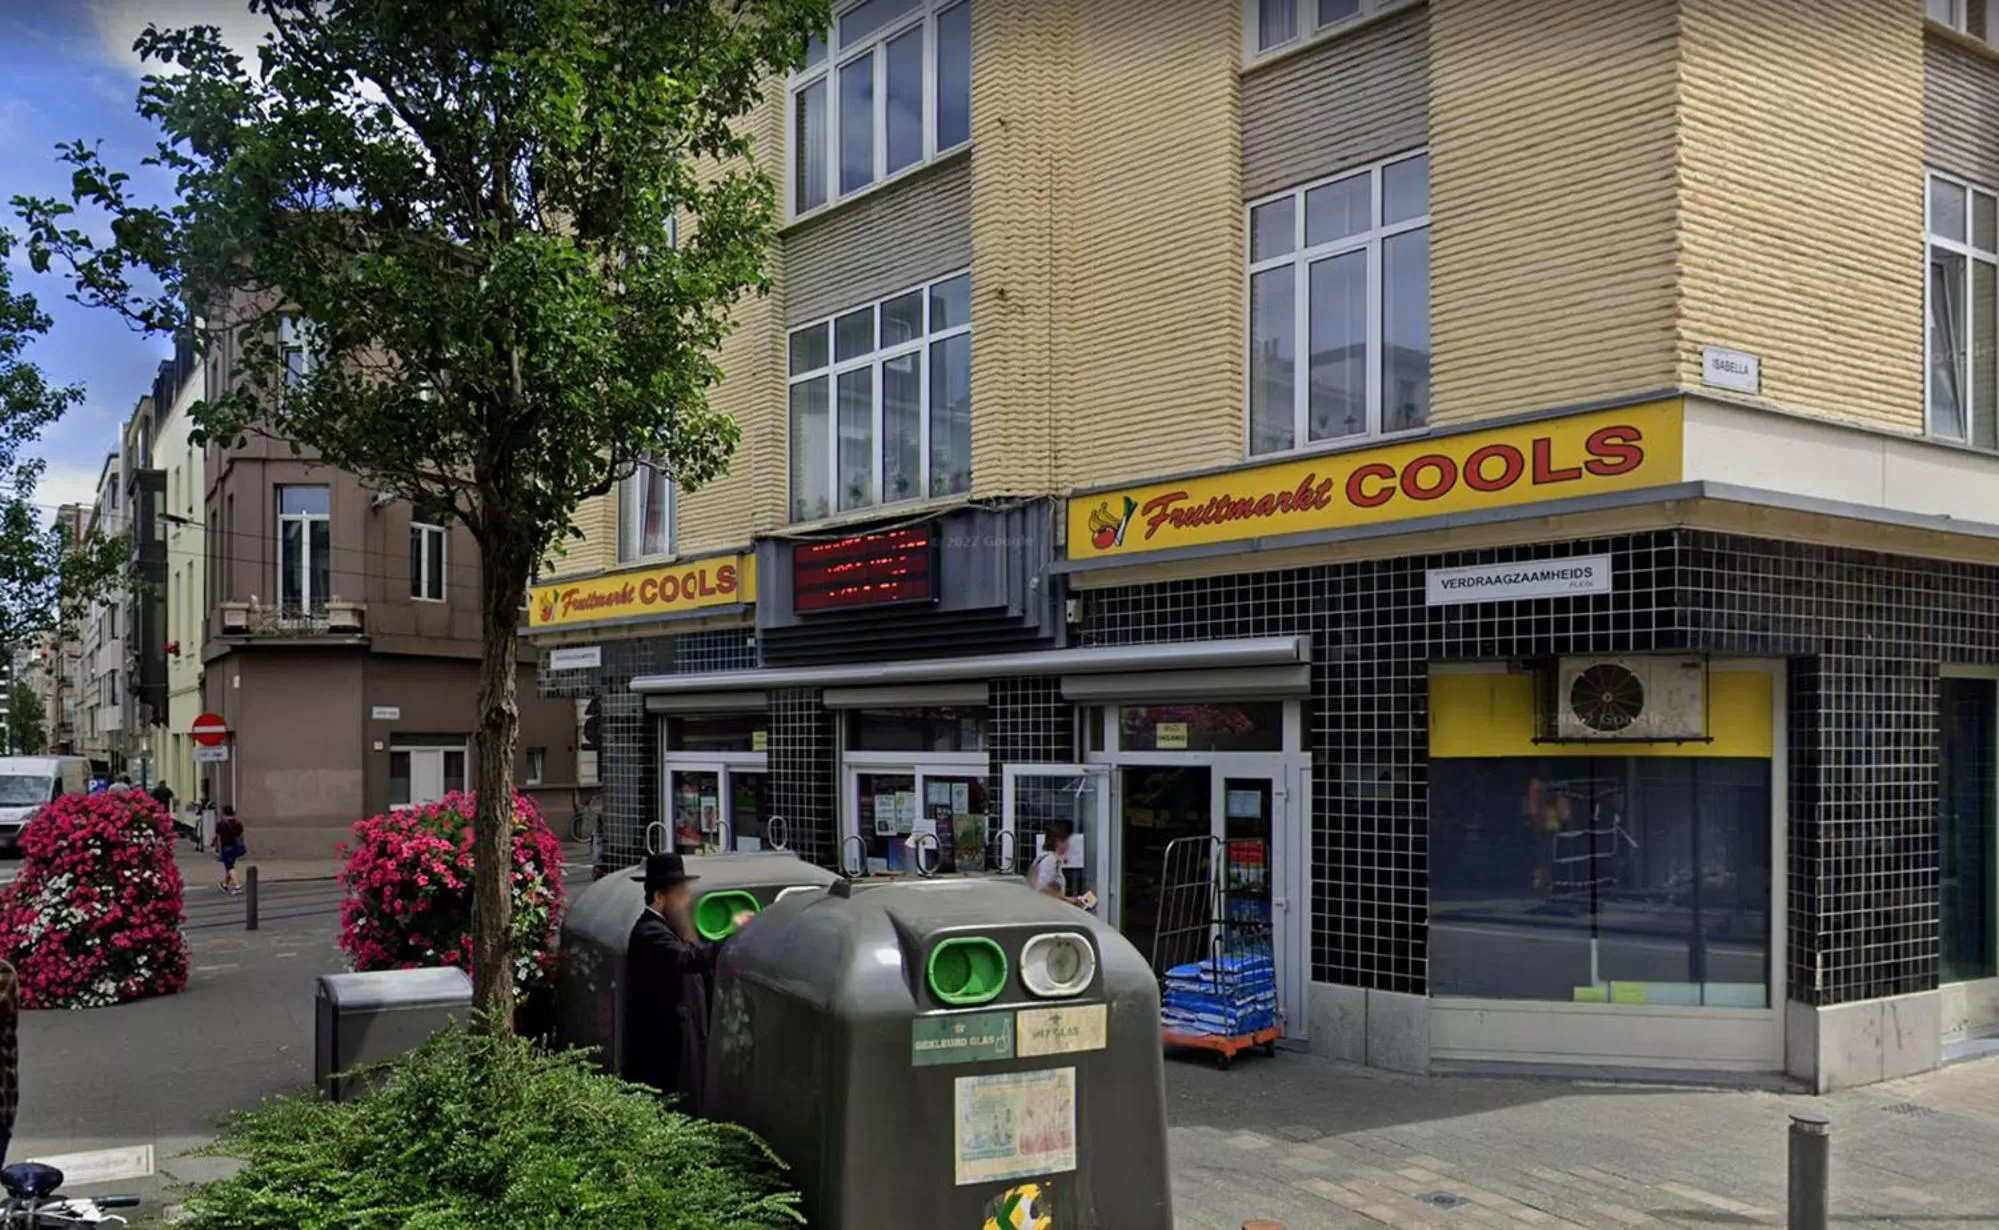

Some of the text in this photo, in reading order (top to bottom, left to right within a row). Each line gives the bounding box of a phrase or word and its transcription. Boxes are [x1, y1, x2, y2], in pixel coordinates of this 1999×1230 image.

[1711, 359, 1749, 375] ISABELLA
[1141, 425, 1645, 540] Fruitmarkt COOLS
[1441, 566, 1593, 589] VERDRAAGZAAMHEIDS
[561, 564, 737, 618] Fruitmarkt COOLS
[969, 1035, 996, 1047] GLAS
